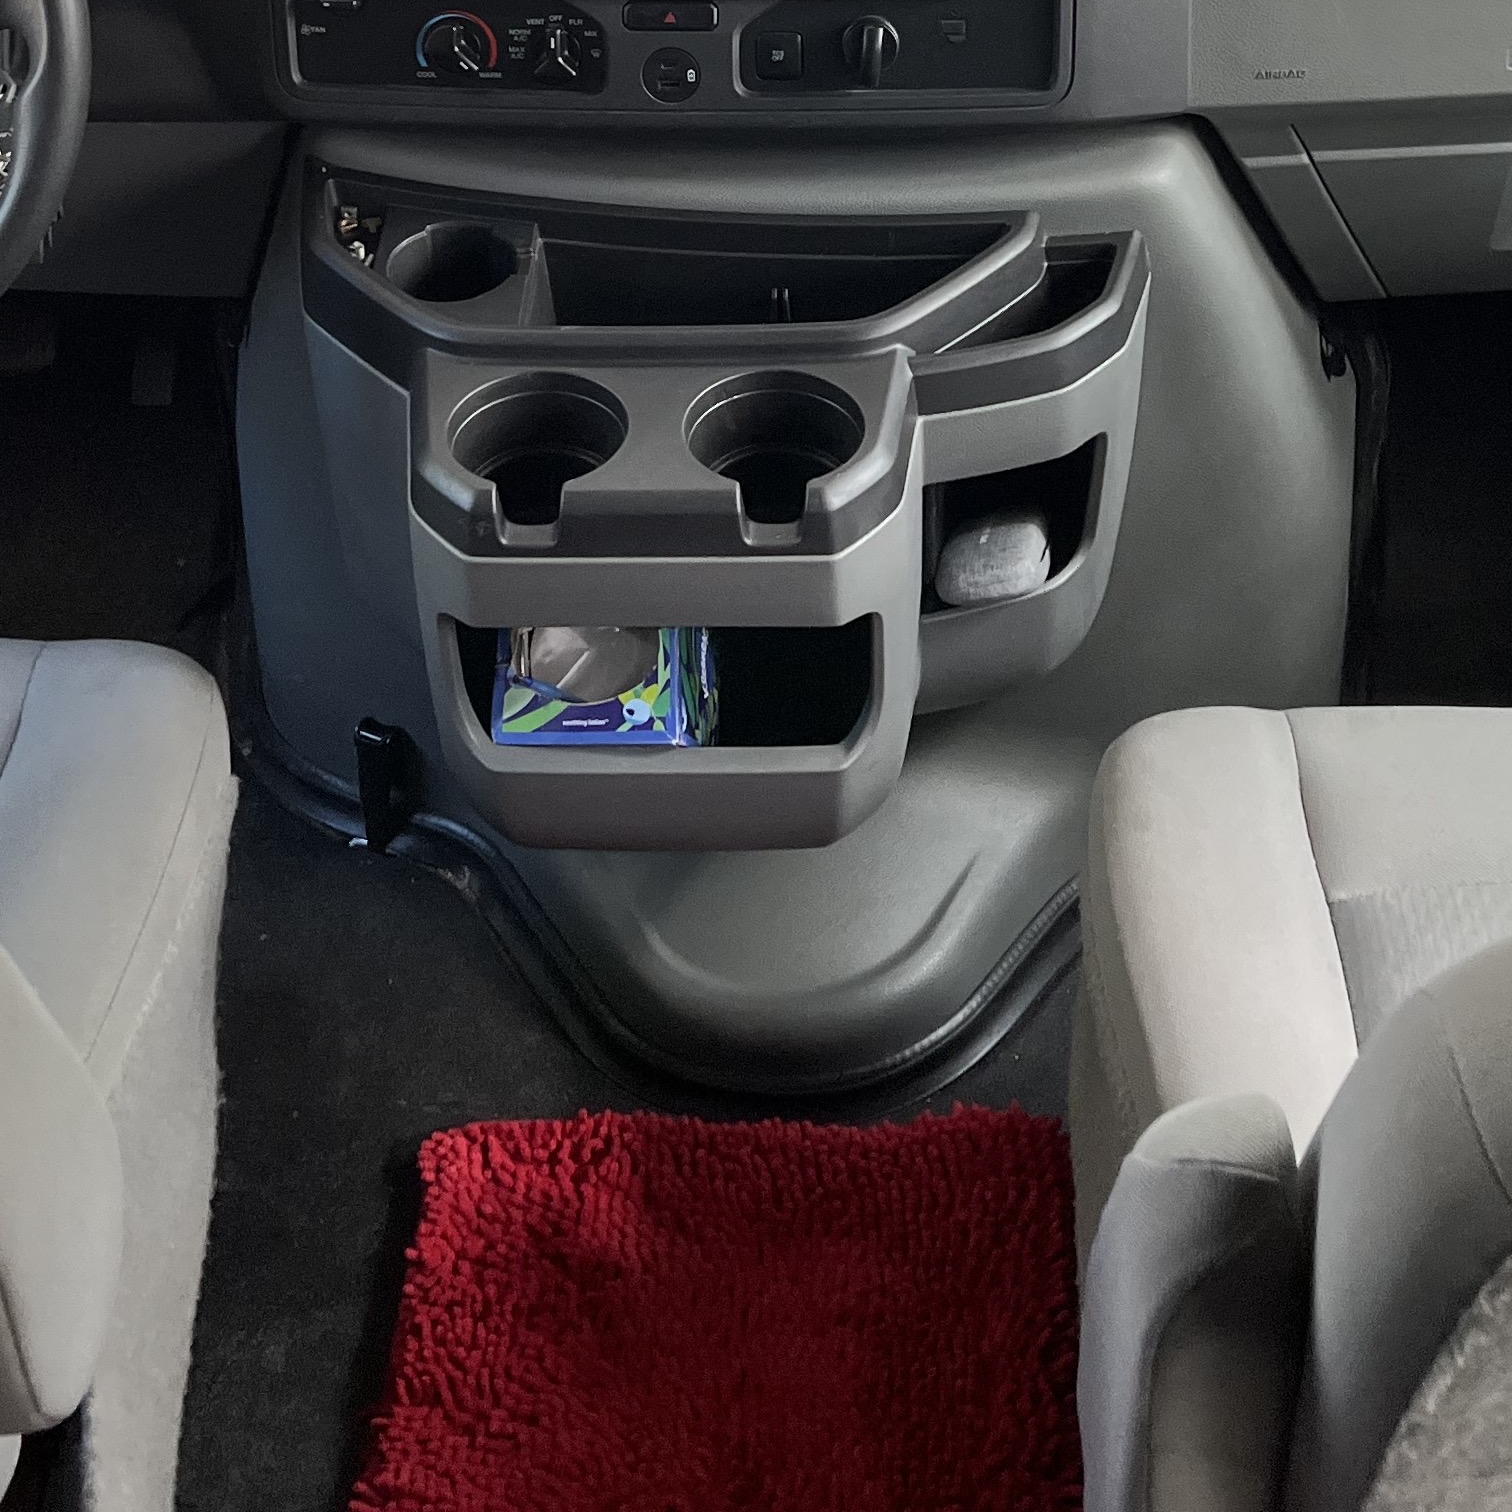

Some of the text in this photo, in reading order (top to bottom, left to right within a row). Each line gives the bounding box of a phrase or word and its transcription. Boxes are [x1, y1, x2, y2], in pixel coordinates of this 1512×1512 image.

[526, 18, 545, 26] VENT
[568, 18, 584, 26] FLR
[478, 71, 502, 79] WARM
